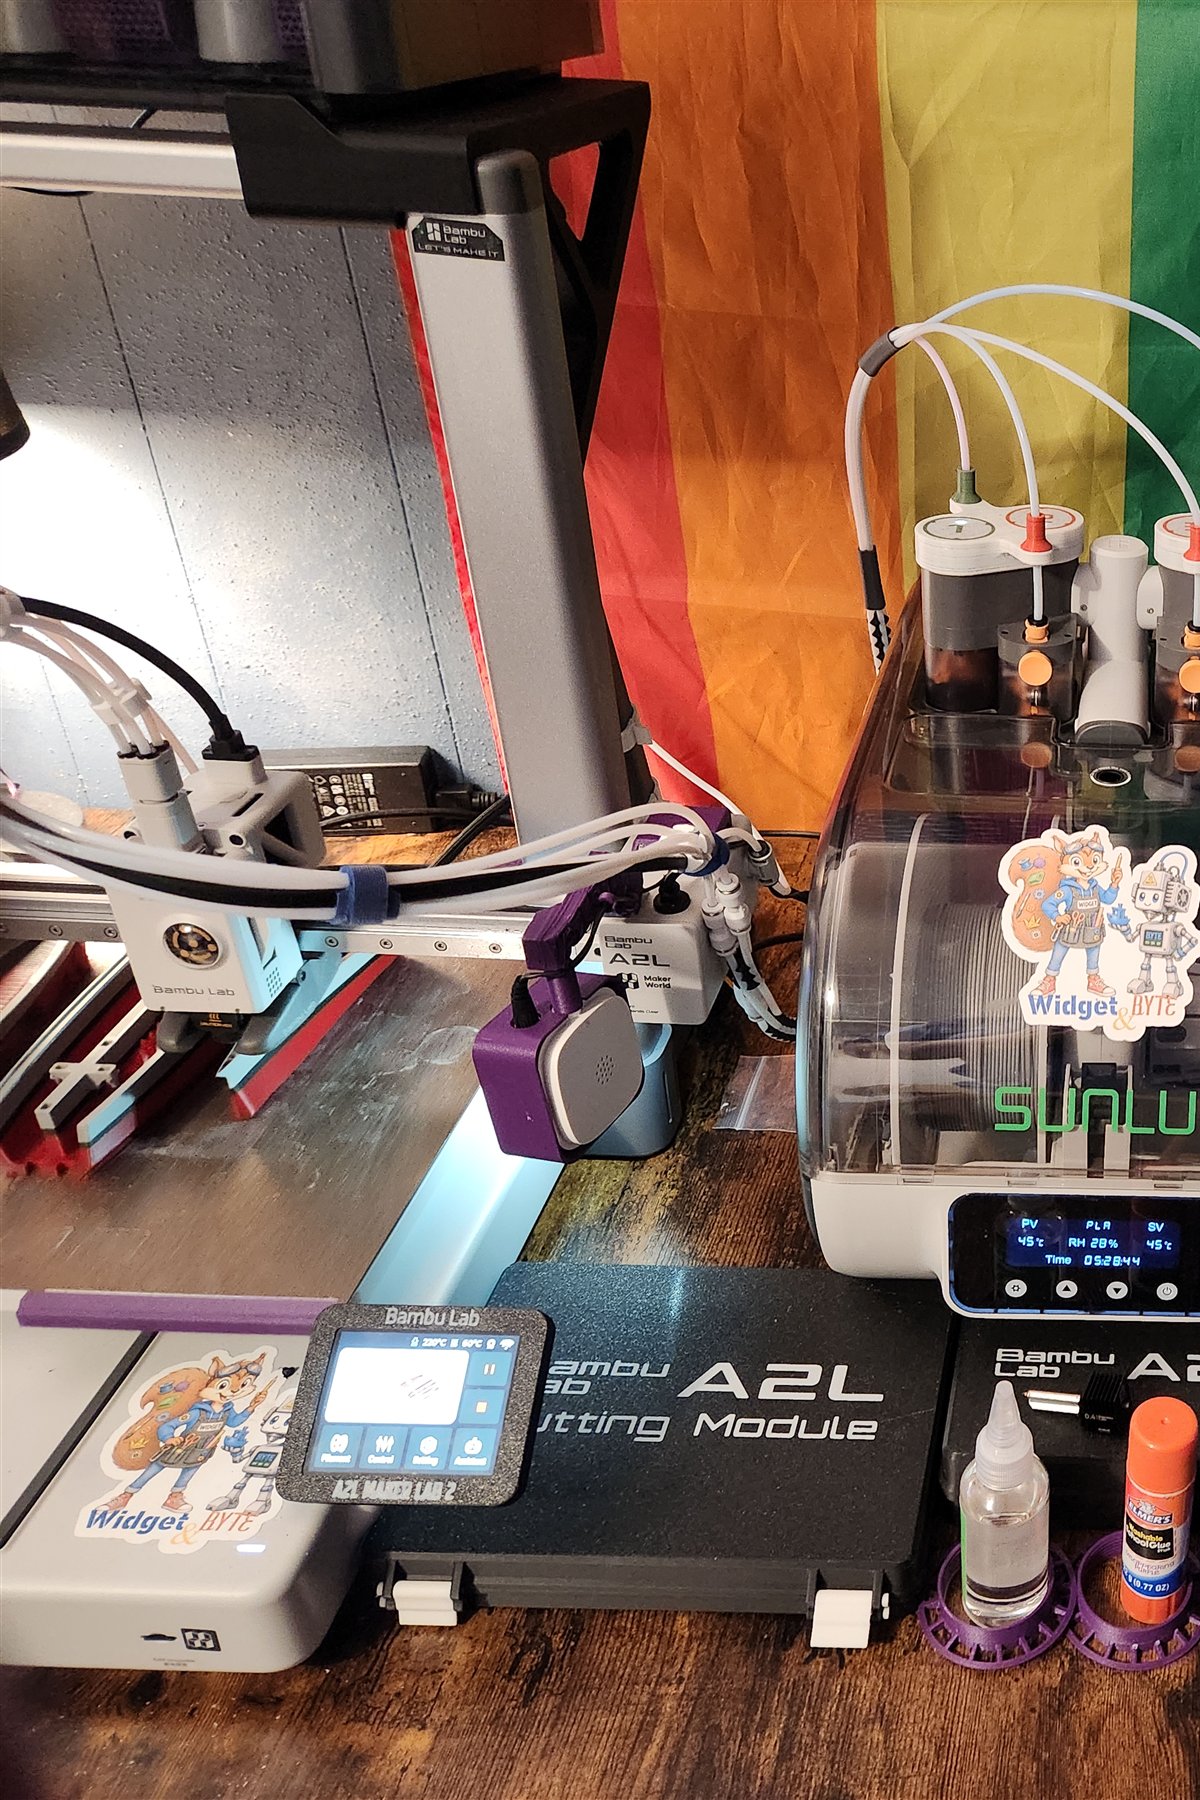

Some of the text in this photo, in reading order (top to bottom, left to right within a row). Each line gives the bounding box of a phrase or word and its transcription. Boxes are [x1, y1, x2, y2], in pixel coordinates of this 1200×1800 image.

[443, 223, 486, 238] Bambu
[444, 233, 467, 245] Lab
[418, 243, 451, 253] LET'S
[453, 247, 487, 256] MAKE
[604, 935, 653, 945] Bambu
[606, 942, 632, 950] Lab
[609, 953, 671, 968] A2L
[643, 975, 672, 983] Maker
[153, 985, 236, 997] Bambu Lab
[1027, 993, 1176, 1031] Widget & BYTE
[994, 1086, 1197, 1136] SUNLU
[1021, 1218, 1165, 1232] PV PLA SV
[1068, 1237, 1086, 1248] RH
[1045, 1254, 1141, 1267] Time 05:28:44
[385, 1307, 481, 1327] Bambu Lab
[995, 1347, 1116, 1365] Bambu
[994, 1362, 1061, 1379] Lab
[543, 1377, 593, 1396] ab
[549, 1360, 884, 1403] ambu A2L
[536, 1410, 879, 1443] utting Module
[443, 1481, 458, 1501] 2
[1128, 1501, 1171, 1524] ELMER'S
[86, 1509, 255, 1545] Widget & BYTE
[1149, 1541, 1172, 1552] Glue
[1133, 1577, 1154, 1592] (0.77
